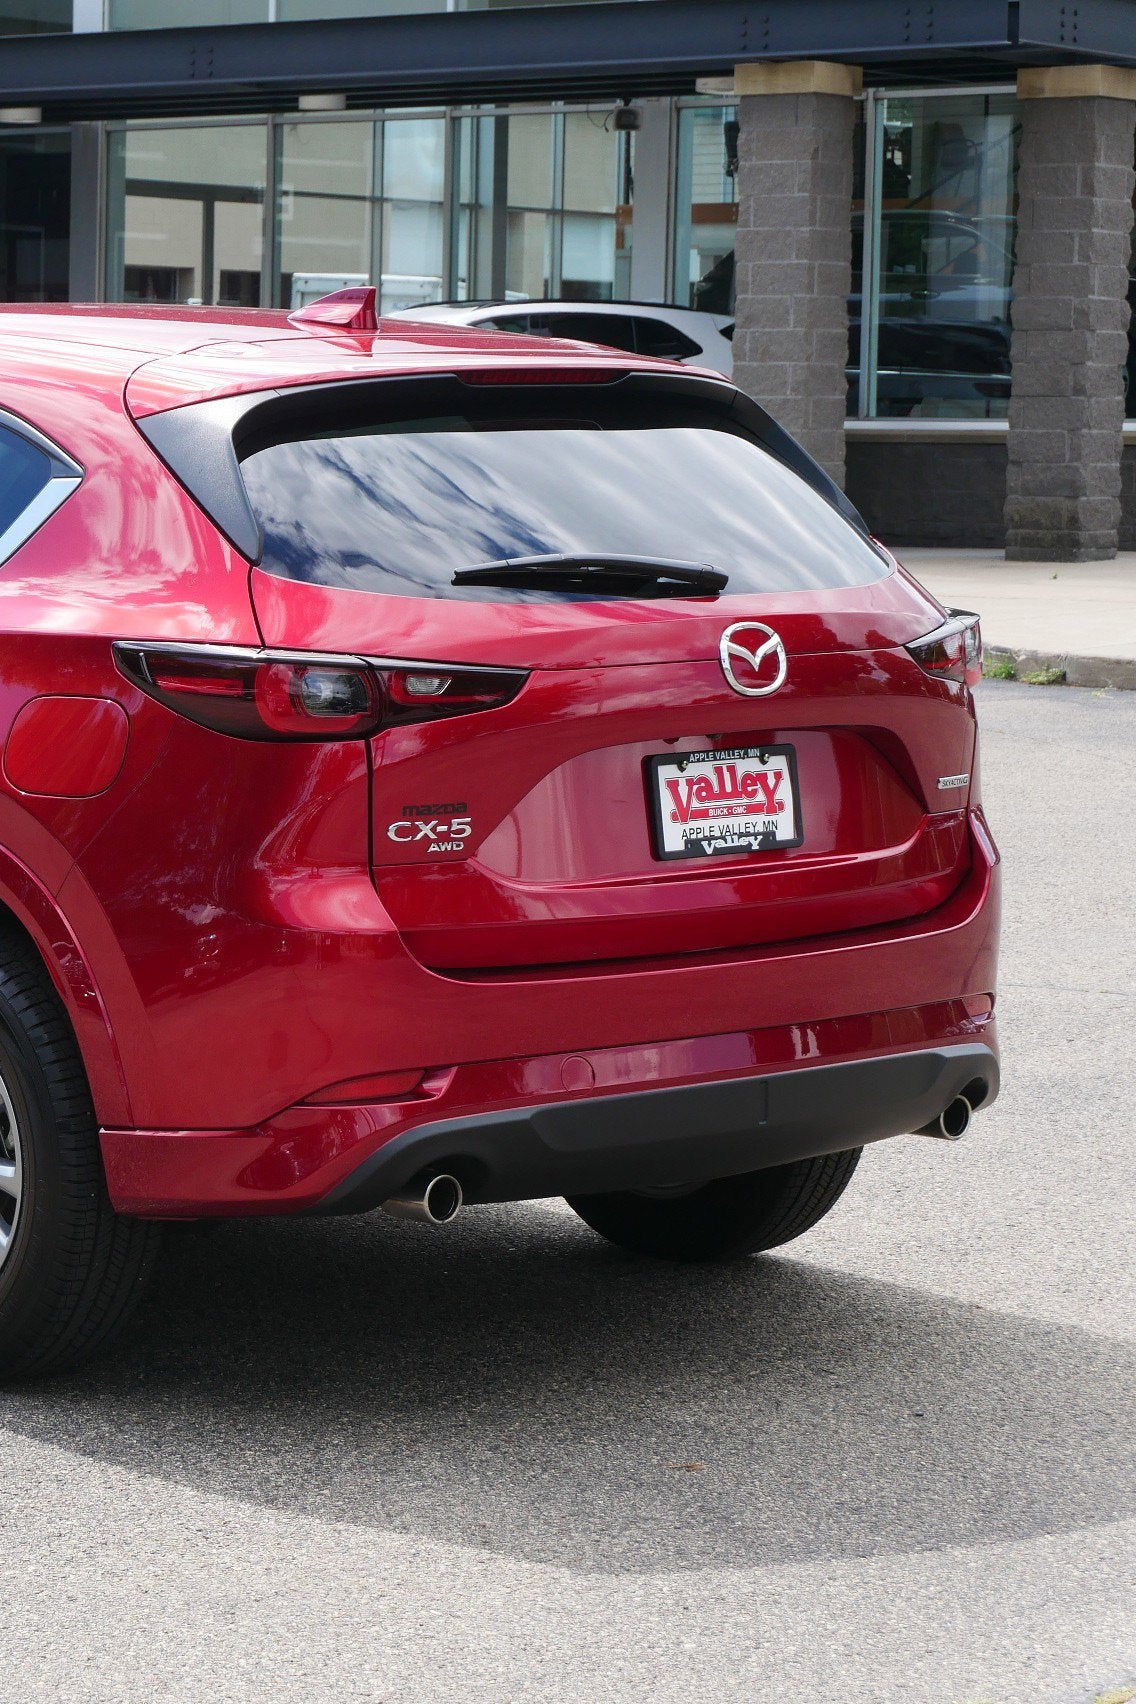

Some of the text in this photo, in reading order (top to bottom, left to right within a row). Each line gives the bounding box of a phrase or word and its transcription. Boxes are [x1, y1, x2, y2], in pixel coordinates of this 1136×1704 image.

[689, 751, 715, 763] APPLE
[748, 748, 760, 758] MN
[665, 763, 784, 824] Valley
[402, 802, 468, 816] mazda
[708, 805, 747, 817] BUICK GMC
[387, 817, 472, 842] CX-5
[681, 825, 715, 840] APPLE
[763, 819, 778, 832] MN
[427, 841, 464, 852] AWD
[701, 834, 763, 855] Valley
